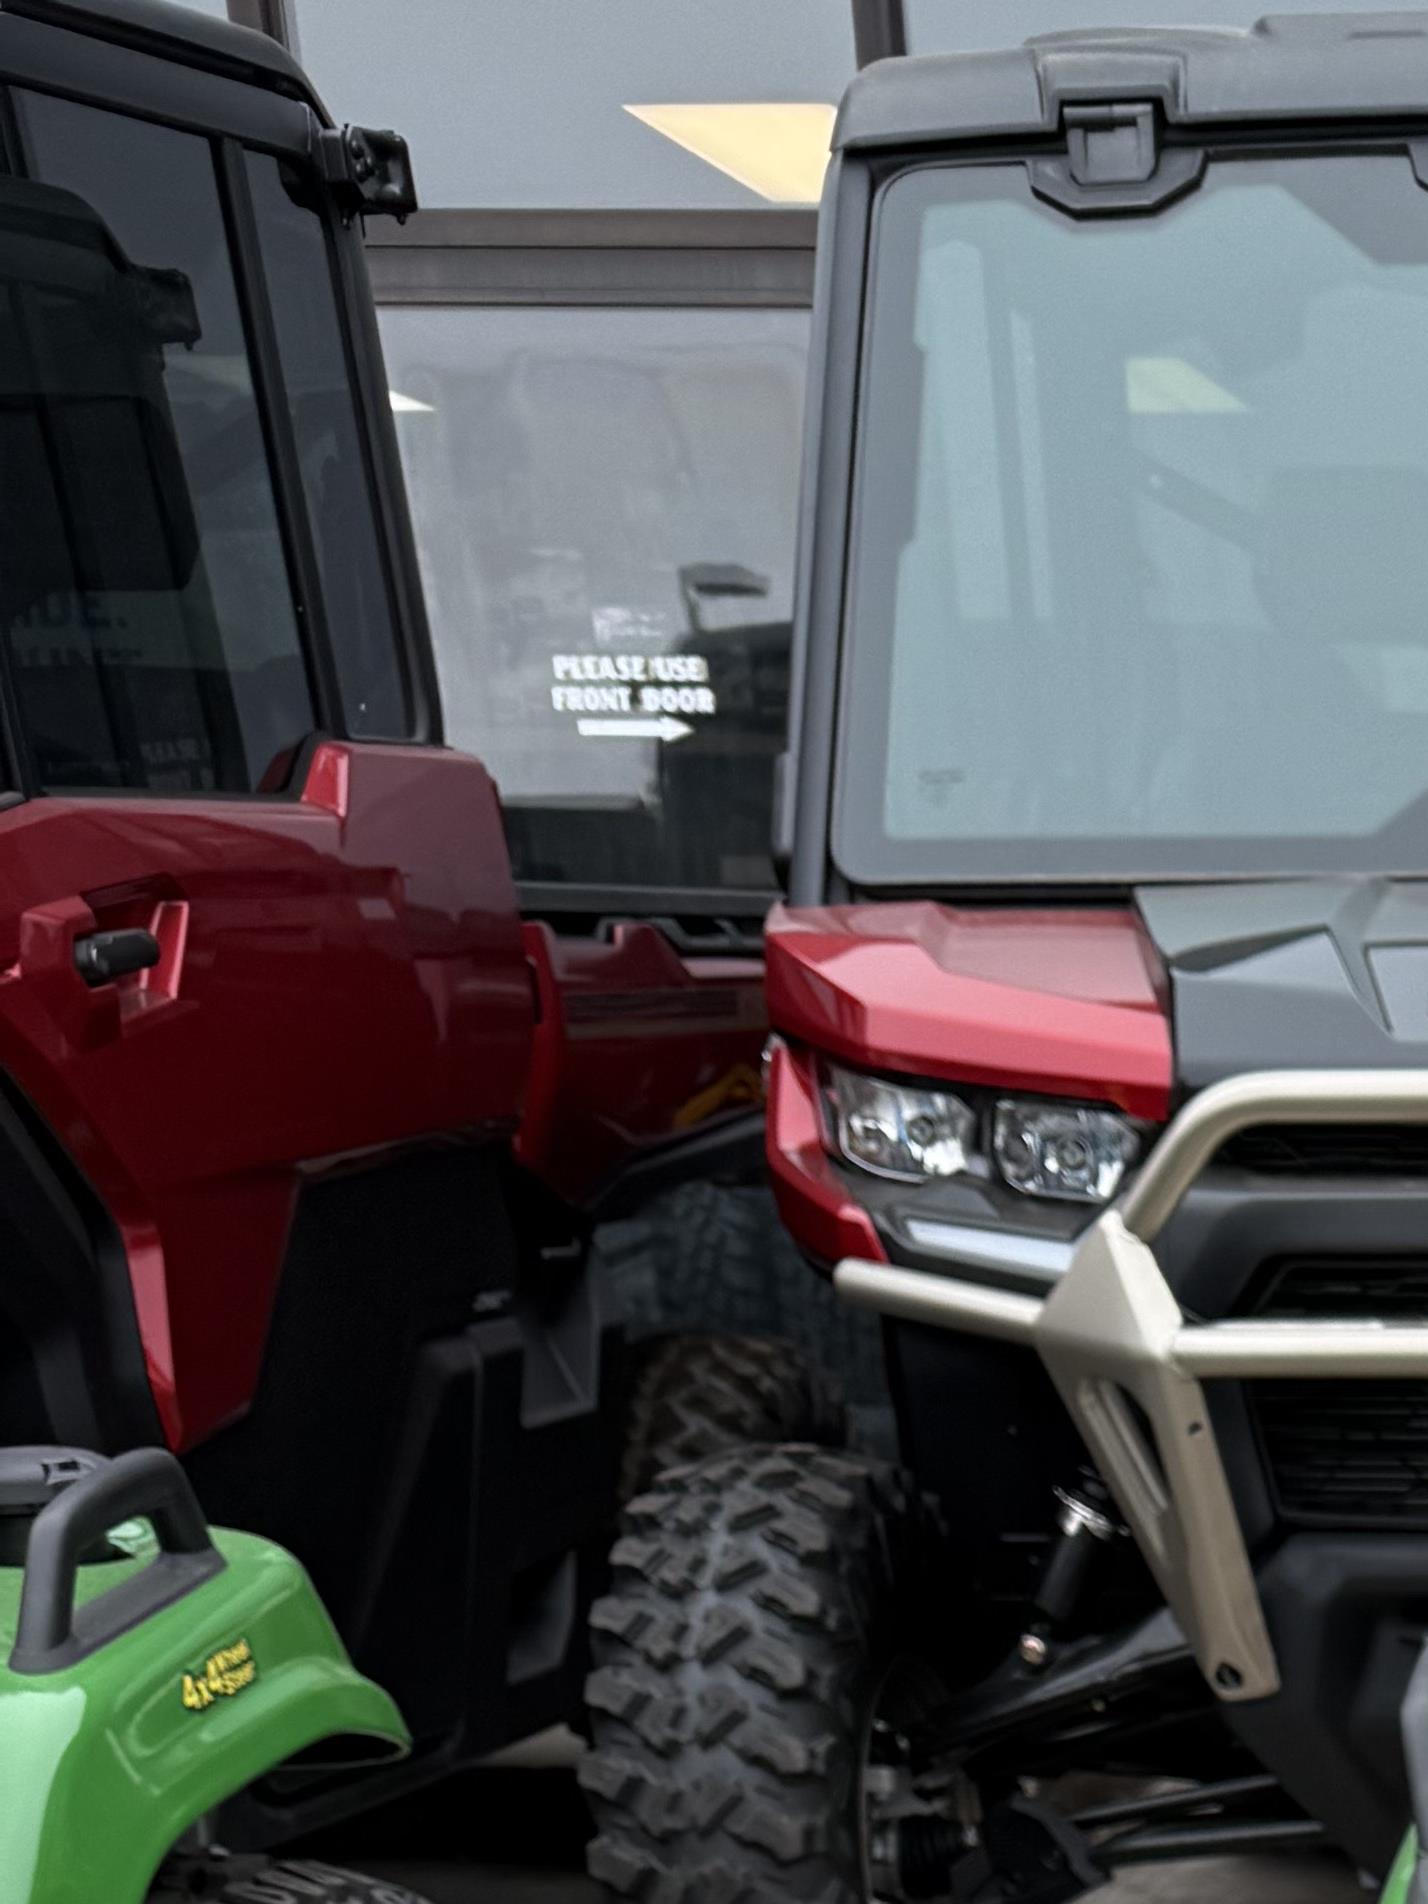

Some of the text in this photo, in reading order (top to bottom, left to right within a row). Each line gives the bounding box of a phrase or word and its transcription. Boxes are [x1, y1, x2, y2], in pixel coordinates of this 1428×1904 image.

[552, 655, 709, 683] PLEASE USE
[551, 685, 717, 715] FRONT DOOR
